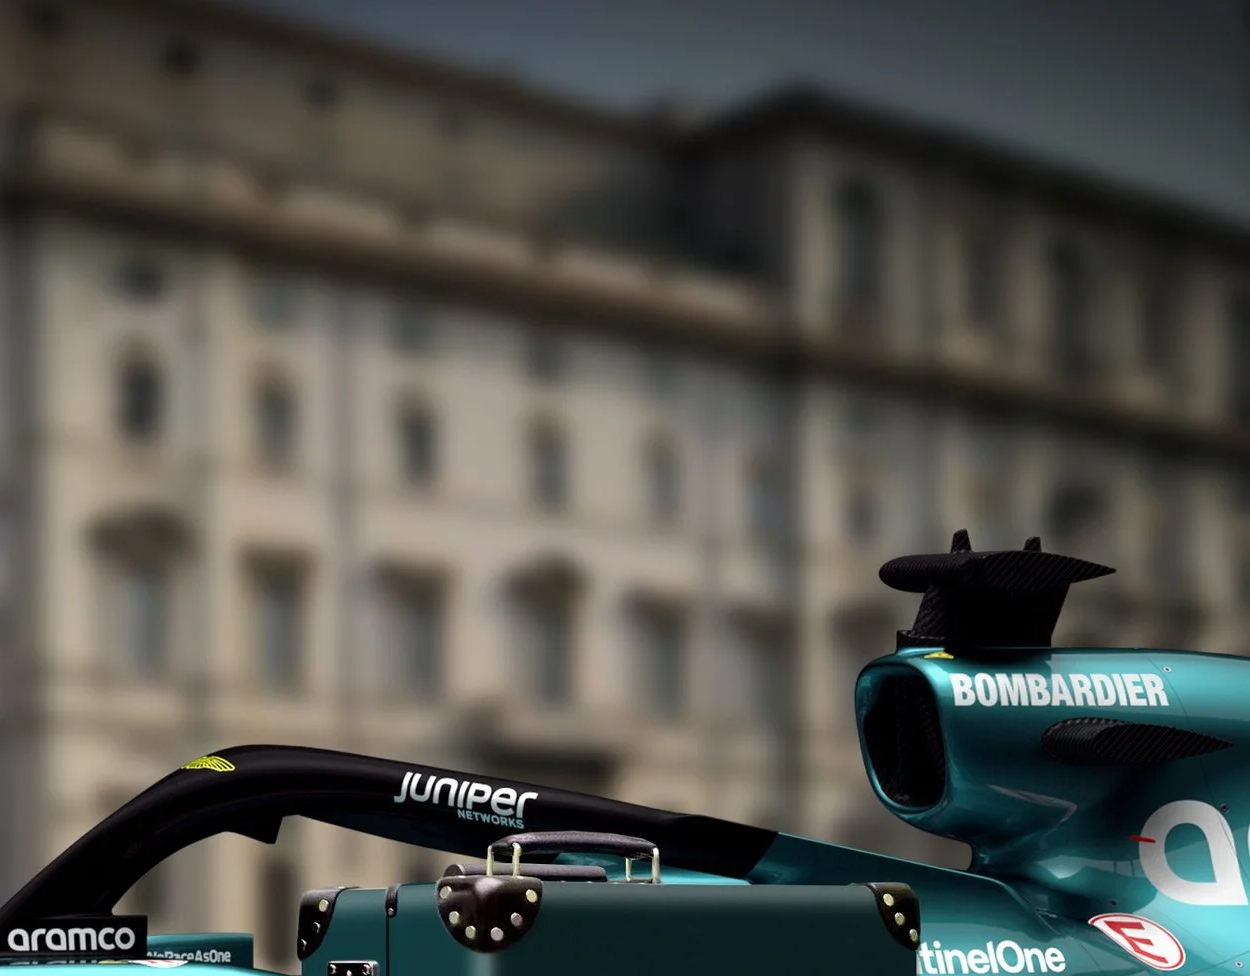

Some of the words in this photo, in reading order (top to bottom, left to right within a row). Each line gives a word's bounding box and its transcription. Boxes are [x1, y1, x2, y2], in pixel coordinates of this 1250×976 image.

[949, 672, 1170, 707] BOMBARDIER
[457, 808, 526, 830] NETWORKS
[7, 926, 136, 951] aramco
